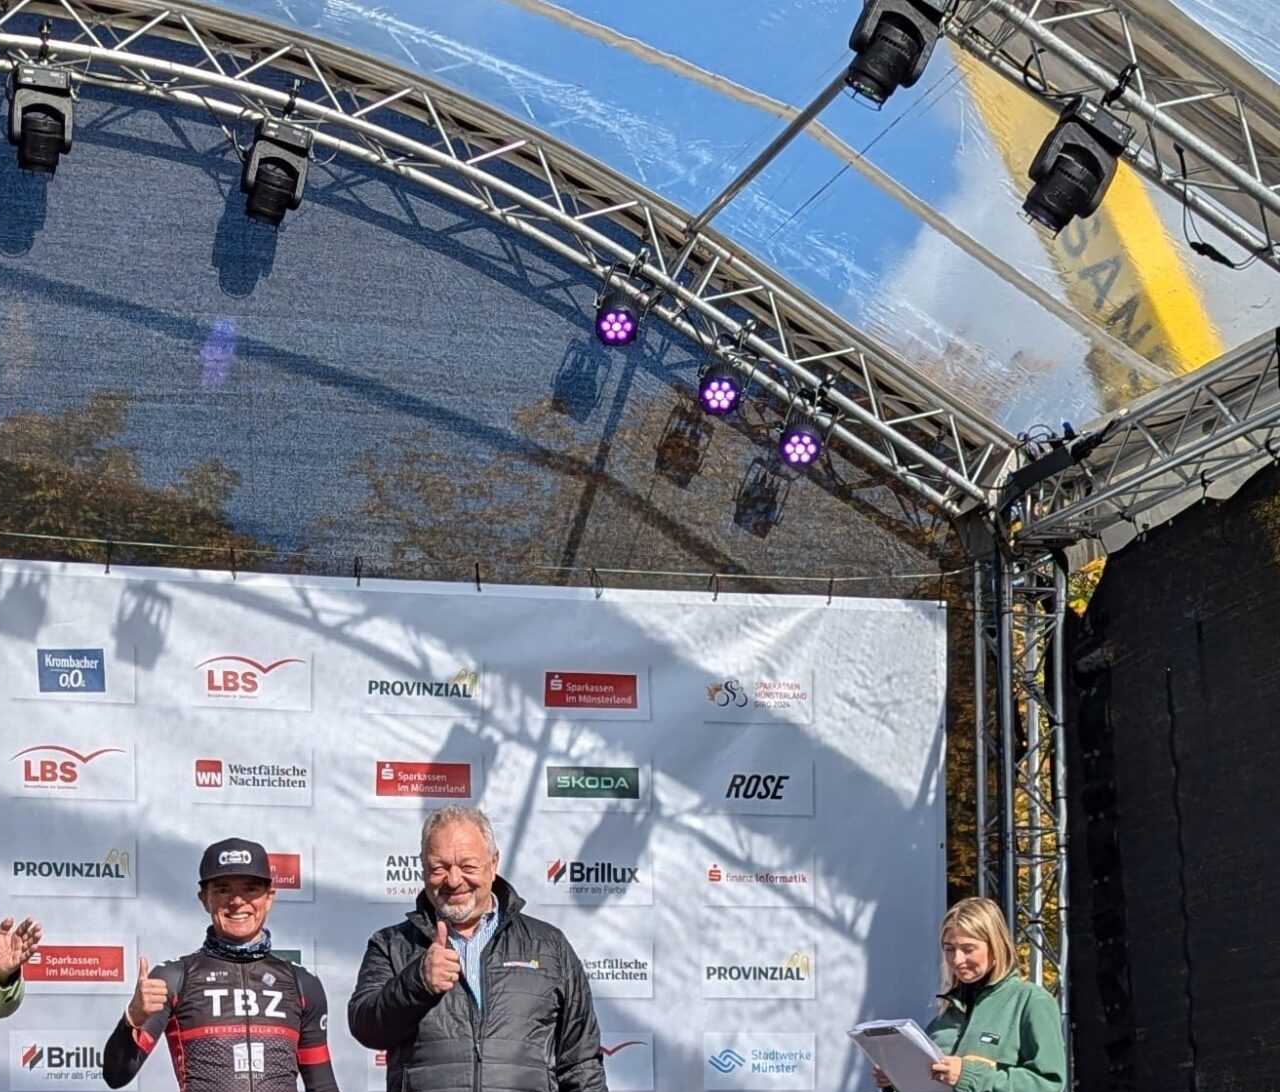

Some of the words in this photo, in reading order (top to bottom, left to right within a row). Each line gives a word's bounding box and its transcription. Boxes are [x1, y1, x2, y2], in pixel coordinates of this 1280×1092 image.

[45, 654, 98, 670] Krombacher
[207, 670, 258, 692] LBS
[566, 682, 614, 695] Sparkassen
[368, 680, 471, 699] PROVINZIAL
[566, 695, 576, 704] im
[578, 694, 632, 705] Münsterland
[24, 760, 78, 783] LBS
[197, 770, 221, 786] WN
[228, 763, 307, 778] Westfälische
[398, 771, 447, 784] Sparkassen
[228, 775, 307, 789] Nachrichten
[398, 783, 408, 793] im
[411, 783, 466, 794] Münsterland
[726, 774, 790, 800] ROSE
[13, 861, 125, 879] PROVINZIAL
[570, 861, 639, 883] Brillux
[726, 873, 753, 884] finanz
[755, 873, 808, 884] informatik
[45, 955, 99, 968] Sparkassen
[584, 959, 648, 969] estfälische
[45, 967, 57, 977] im
[59, 967, 119, 978] Münsterland
[706, 966, 805, 981] PROVINZIAL
[204, 988, 287, 1018] TBZ
[47, 1047, 104, 1068] Brillu
[751, 1049, 811, 1062] Stadtwerke
[751, 1062, 797, 1074] Münster
